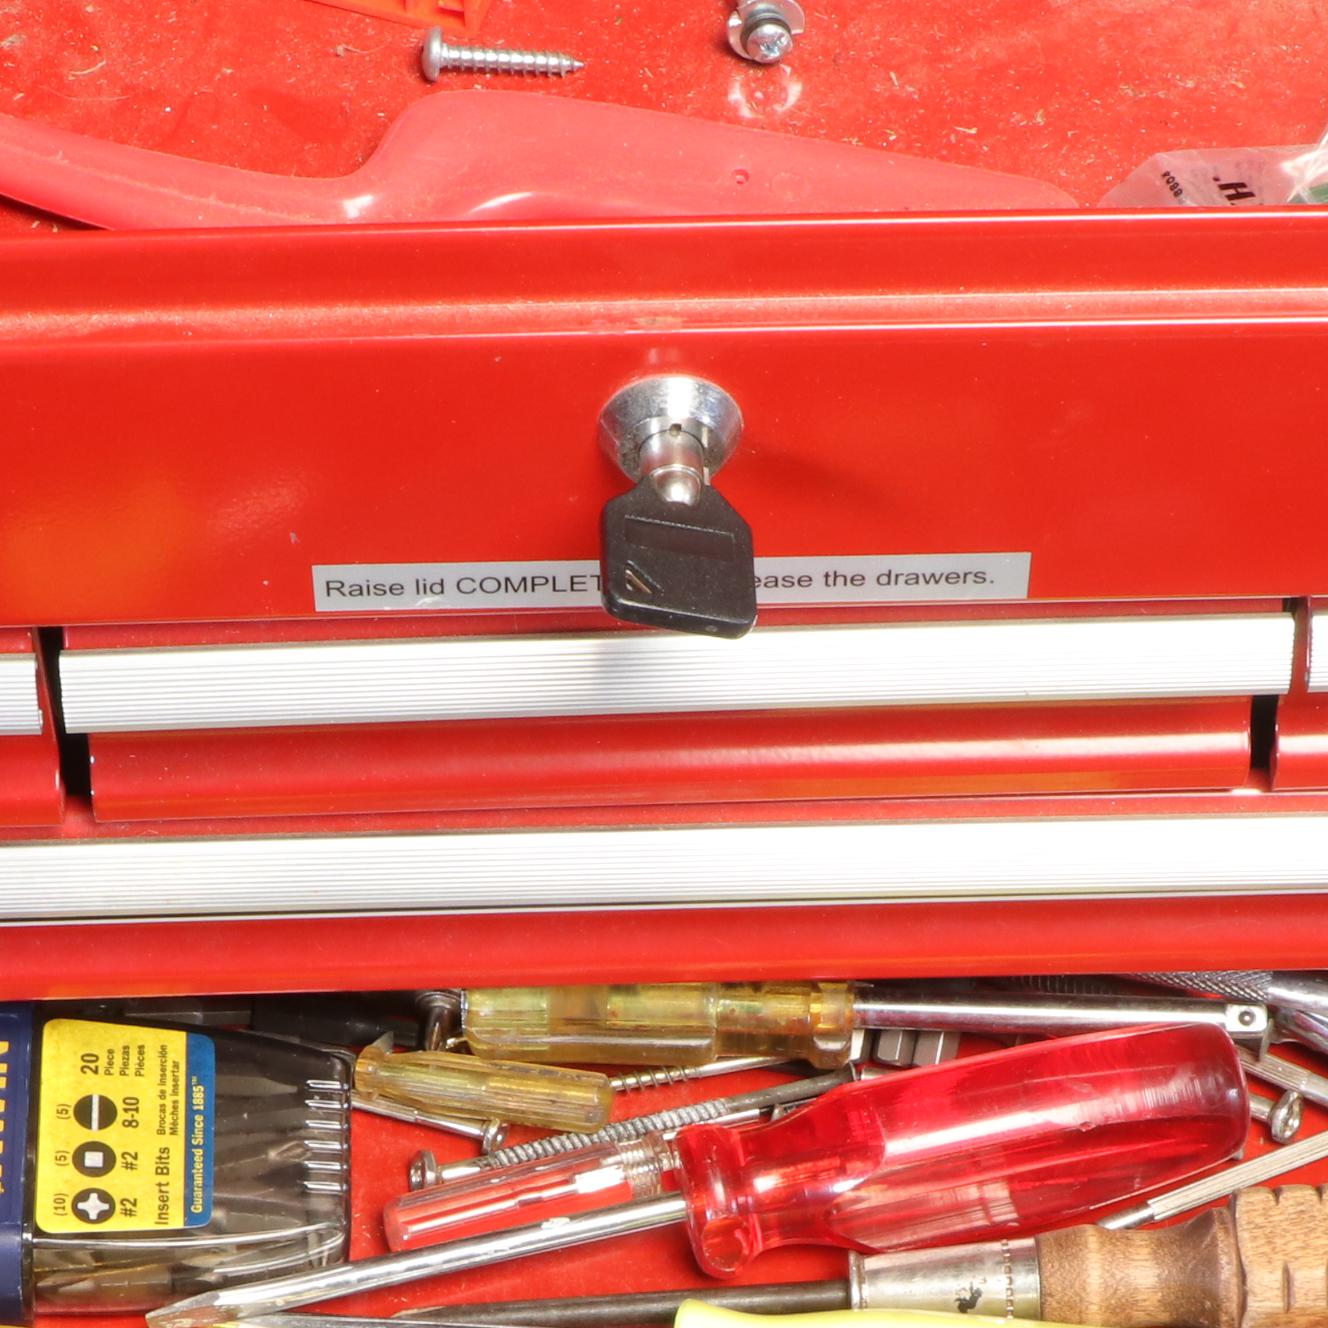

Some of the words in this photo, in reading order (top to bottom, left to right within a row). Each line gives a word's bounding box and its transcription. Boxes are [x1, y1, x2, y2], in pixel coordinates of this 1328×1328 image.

[325, 579, 405, 598] Raise
[415, 577, 445, 596] lid
[823, 570, 866, 588] the
[876, 568, 995, 587] drawers.
[81, 1053, 99, 1075] 20
[104, 1048, 116, 1076] Piece
[119, 1044, 130, 1076] Piezas
[157, 1044, 168, 1086] inserción
[170, 1060, 180, 1096] insertar
[157, 1088, 168, 1101] de
[55, 1103, 72, 1120] (5)
[122, 1096, 140, 1129] 8-10
[157, 1102, 168, 1136] Brocas
[191, 1111, 204, 1146] Since
[54, 1150, 70, 1167] (5)
[121, 1151, 138, 1171] #2
[154, 1146, 170, 1176] Bits
[190, 1148, 204, 1213] Guaranteed
[53, 1193, 69, 1217] (10)
[120, 1197, 138, 1218] #2
[154, 1178, 170, 1226] Insert
